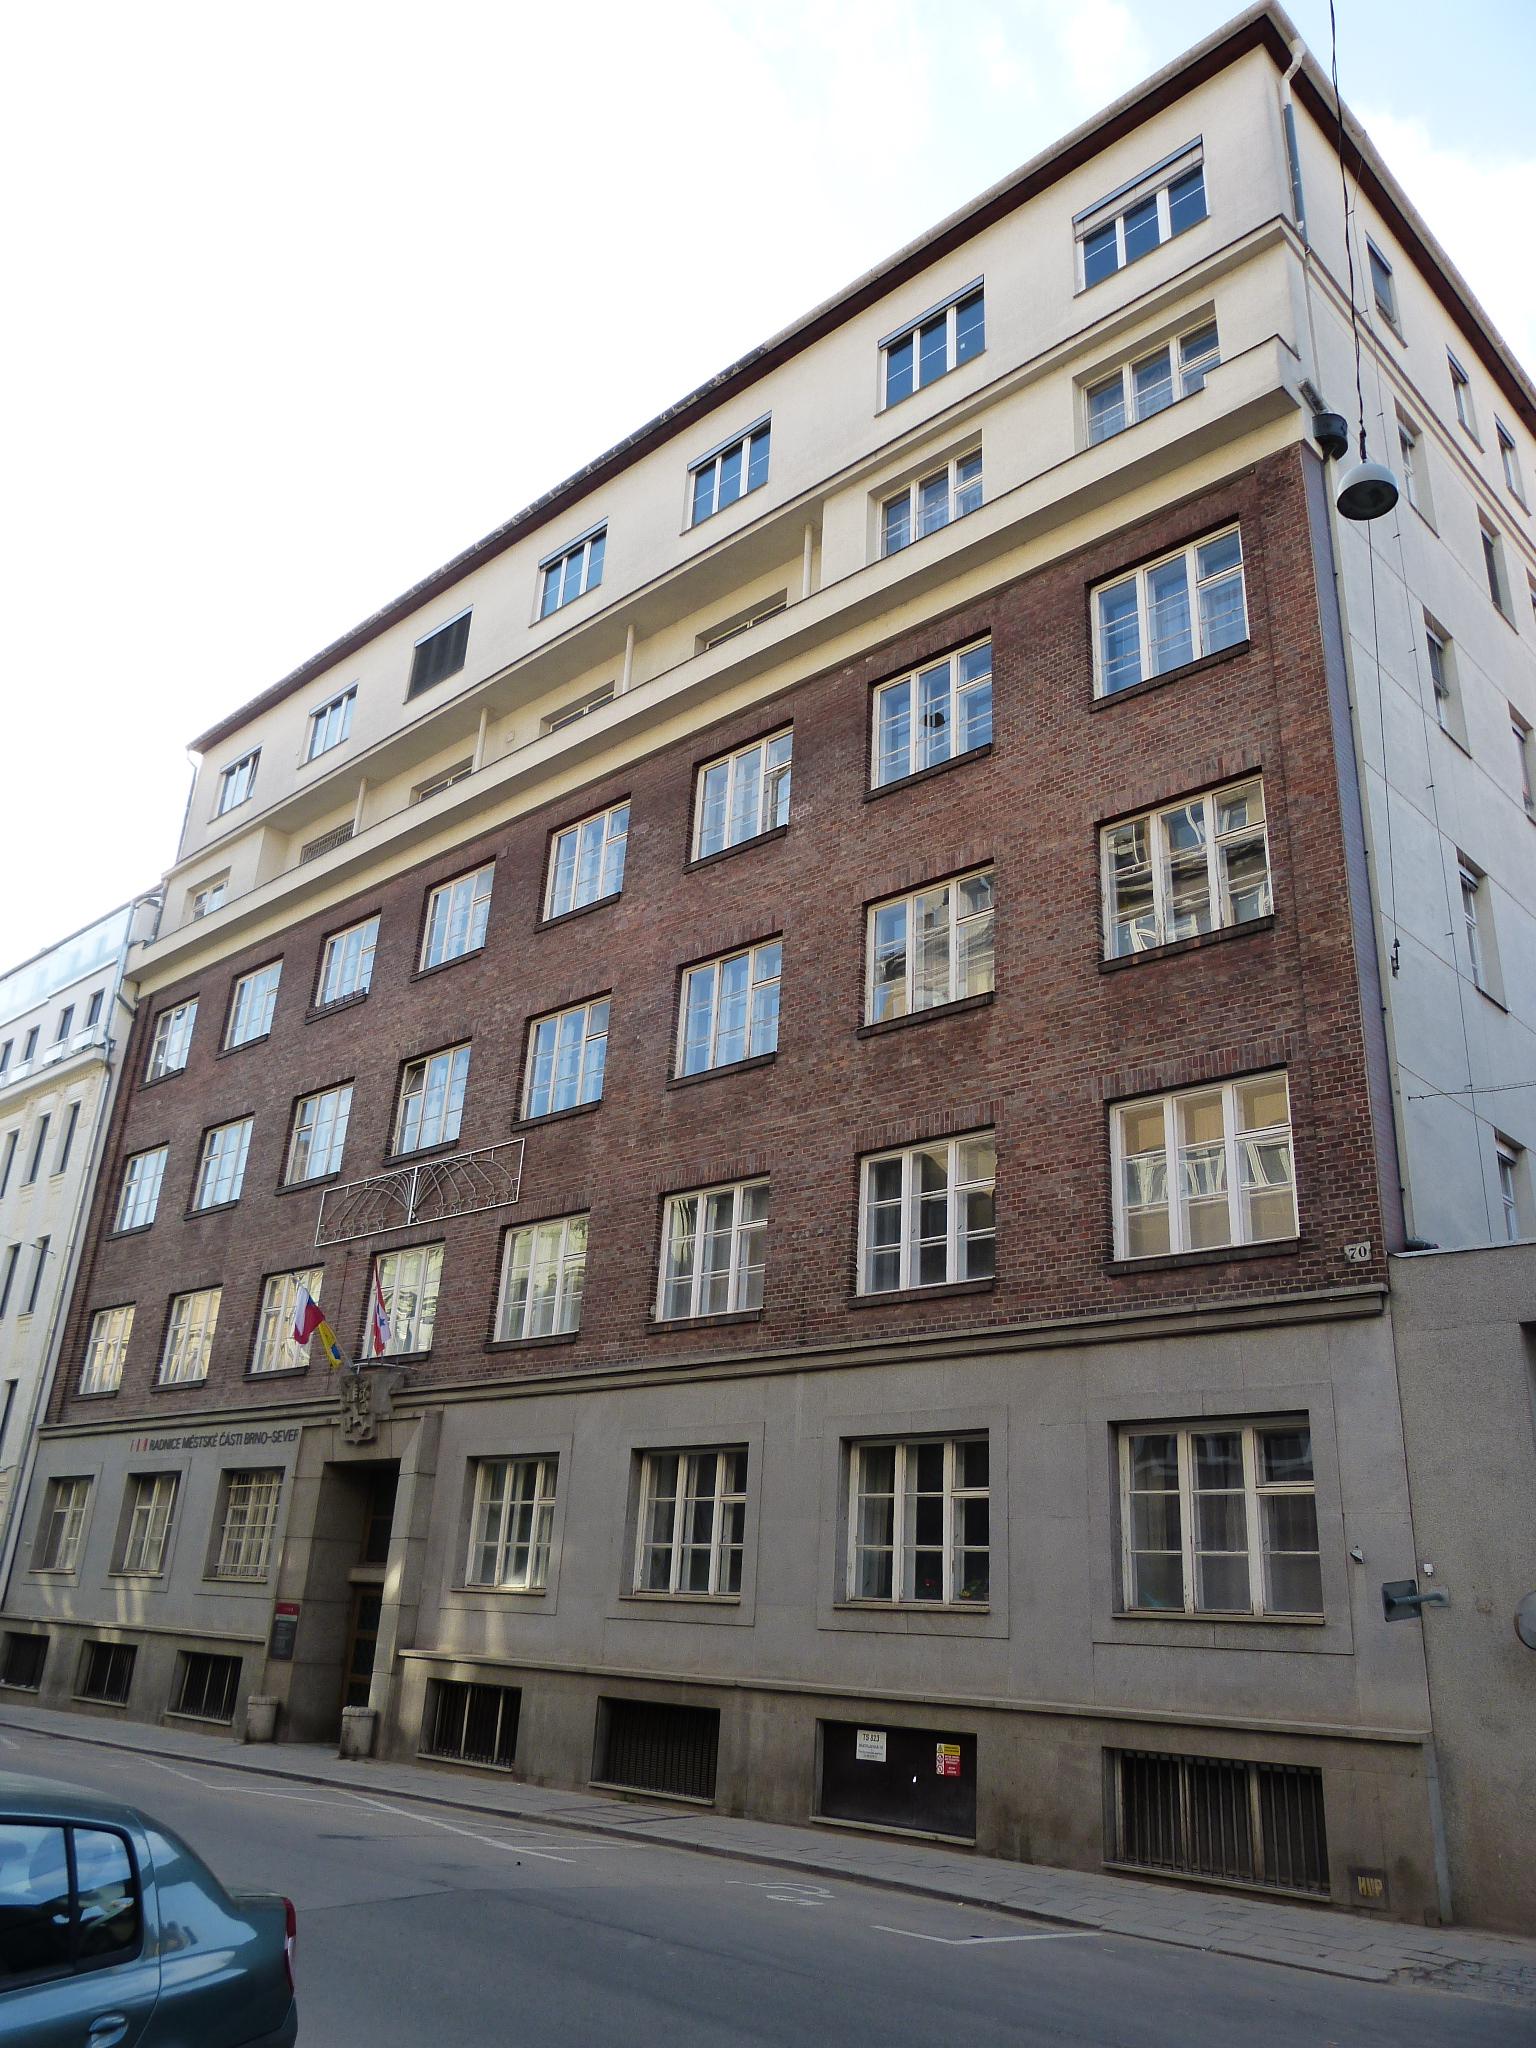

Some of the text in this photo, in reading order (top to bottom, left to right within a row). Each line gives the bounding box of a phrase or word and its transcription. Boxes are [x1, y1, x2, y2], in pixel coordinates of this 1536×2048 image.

[1349, 1246, 1366, 1259] 70
[149, 1438, 181, 1451] RADNICE
[182, 1432, 218, 1449] MĚSTSKÉ
[219, 1431, 243, 1446] ČÁSTI
